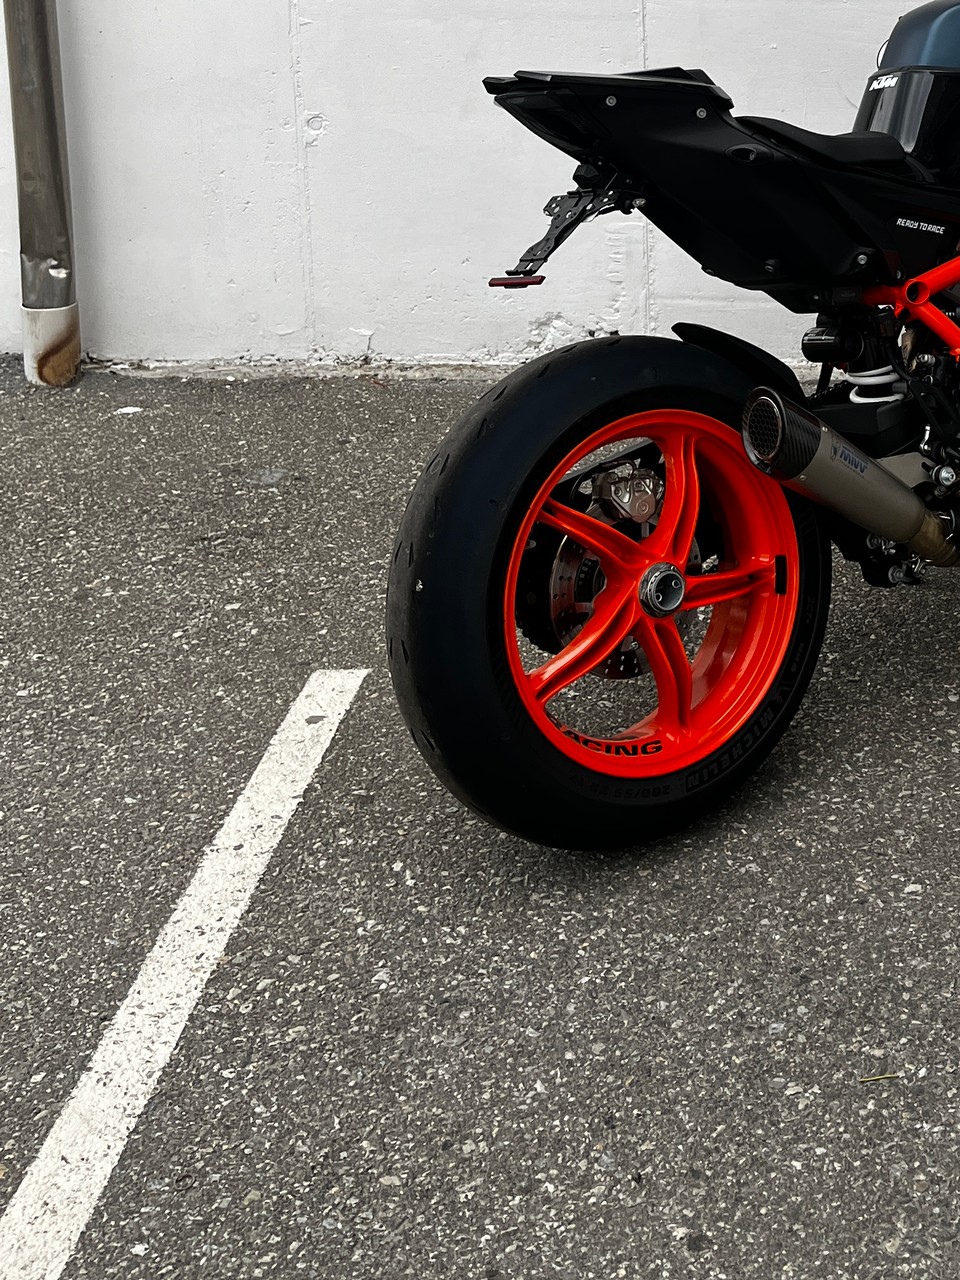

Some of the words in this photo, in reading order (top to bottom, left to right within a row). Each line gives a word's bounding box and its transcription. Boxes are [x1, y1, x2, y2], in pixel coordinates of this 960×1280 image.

[869, 74, 899, 91] KTM
[896, 218, 919, 229] READY
[919, 222, 928, 231] TO
[927, 223, 946, 235] RACE
[687, 707, 775, 789] MICHELIN
